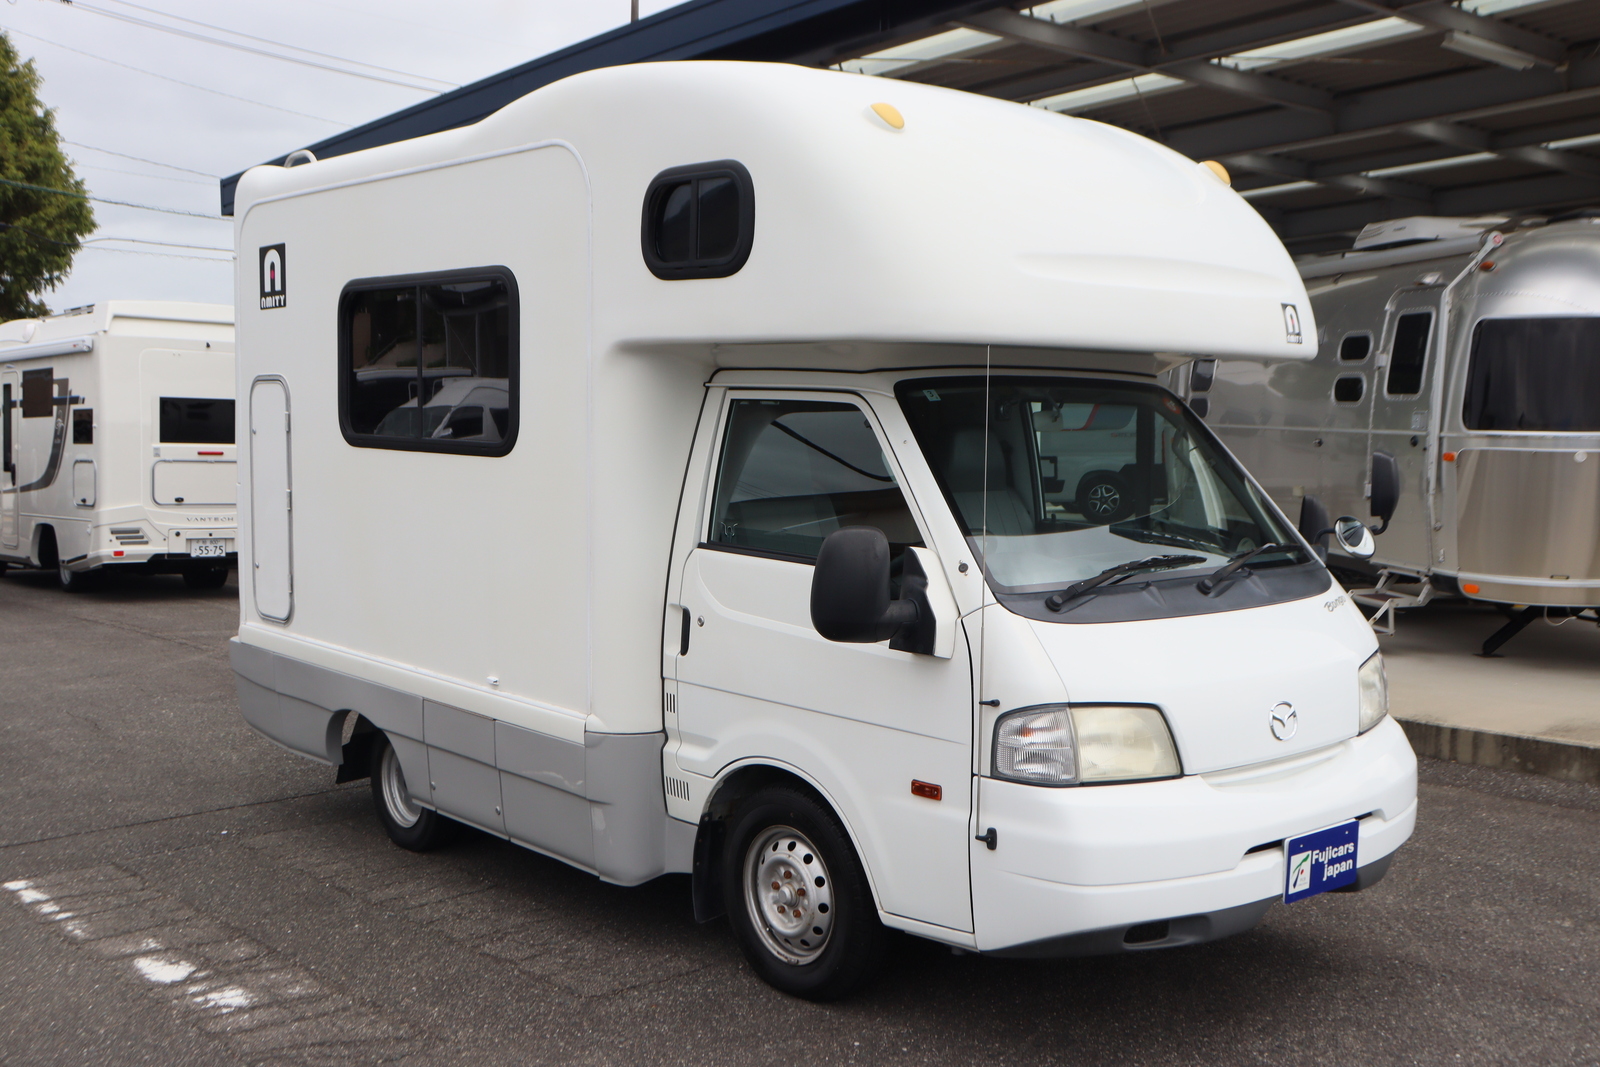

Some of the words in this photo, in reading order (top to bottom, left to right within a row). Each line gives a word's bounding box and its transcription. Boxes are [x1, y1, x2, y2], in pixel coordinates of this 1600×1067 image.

[261, 294, 285, 309] AMITY
[198, 545, 224, 555] 55-75
[1312, 842, 1355, 865] Fujicars
[1322, 859, 1354, 882] japan
